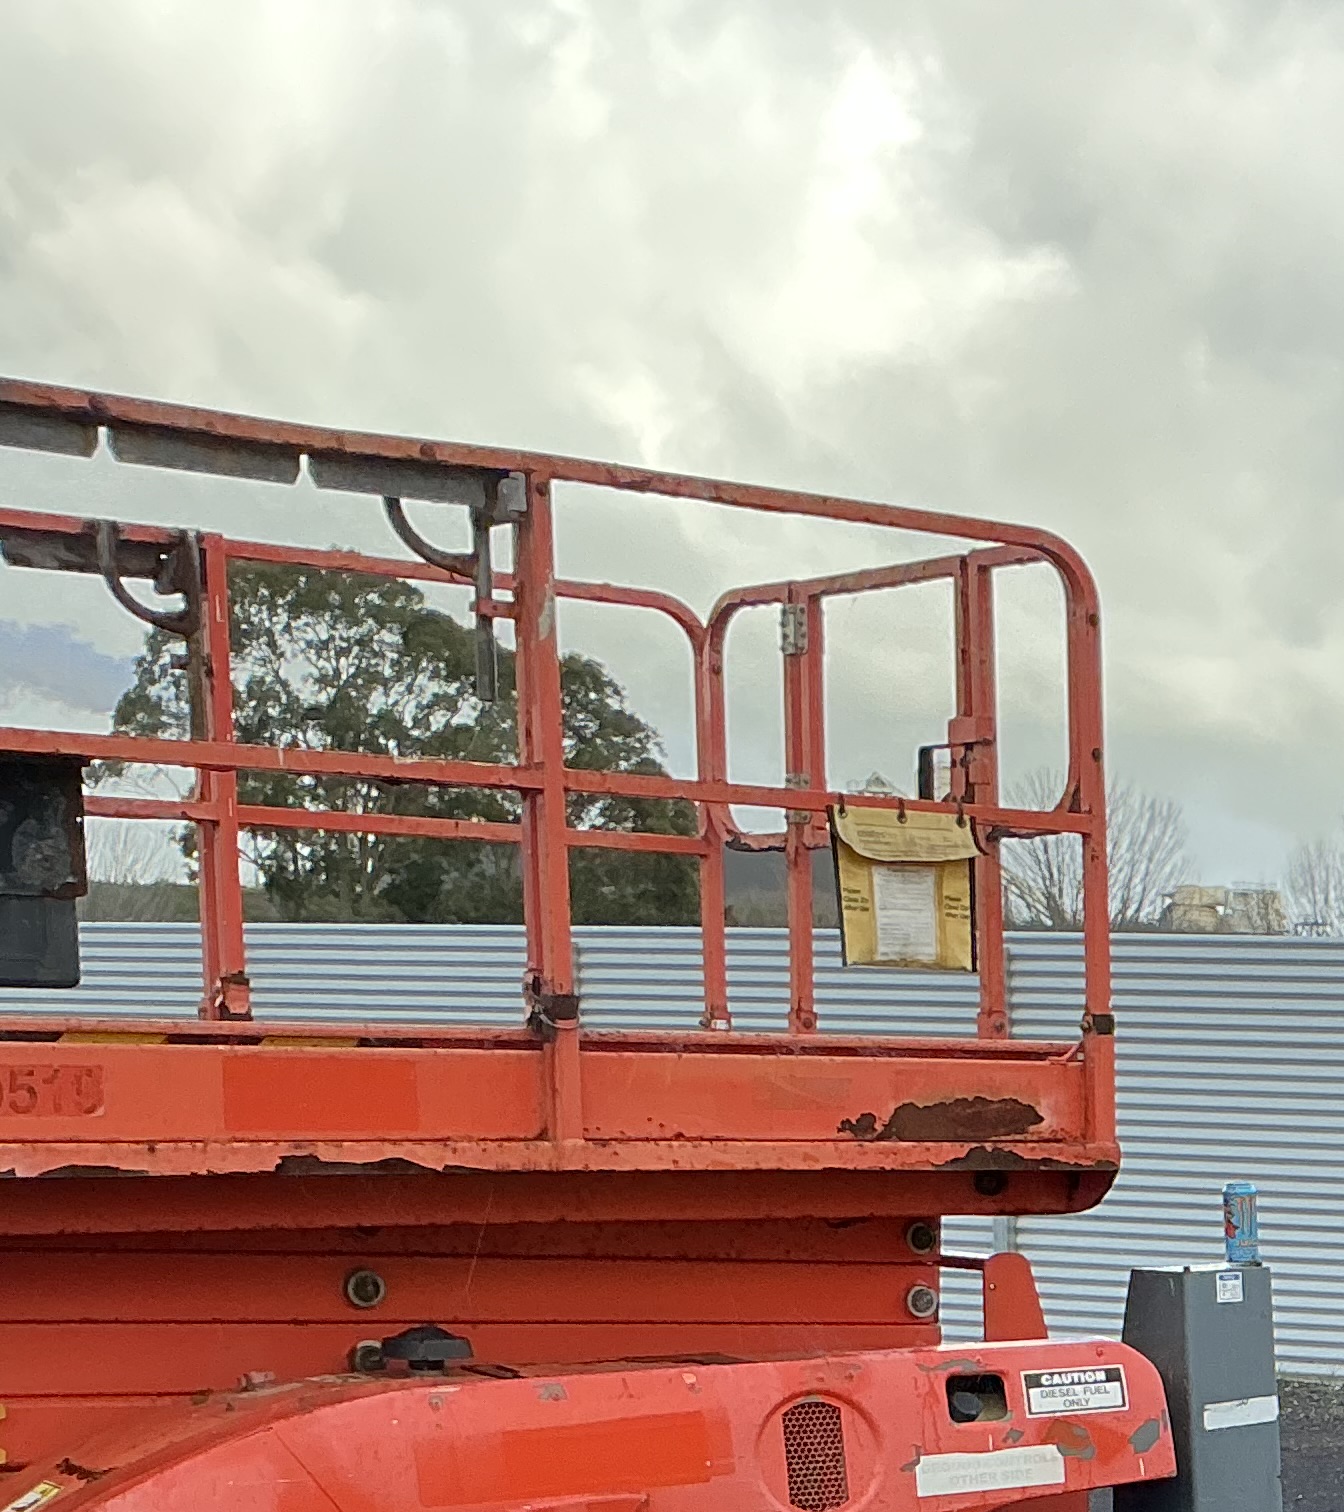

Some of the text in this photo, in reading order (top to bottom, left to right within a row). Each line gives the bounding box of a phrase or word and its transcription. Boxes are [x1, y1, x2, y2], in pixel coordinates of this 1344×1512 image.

[1040, 1370, 1107, 1386] CAUTION
[1040, 1384, 1110, 1399] DIESEL FUEL
[1063, 1397, 1091, 1408] ONLY
[950, 1468, 1033, 1487] OTHER SIDE
